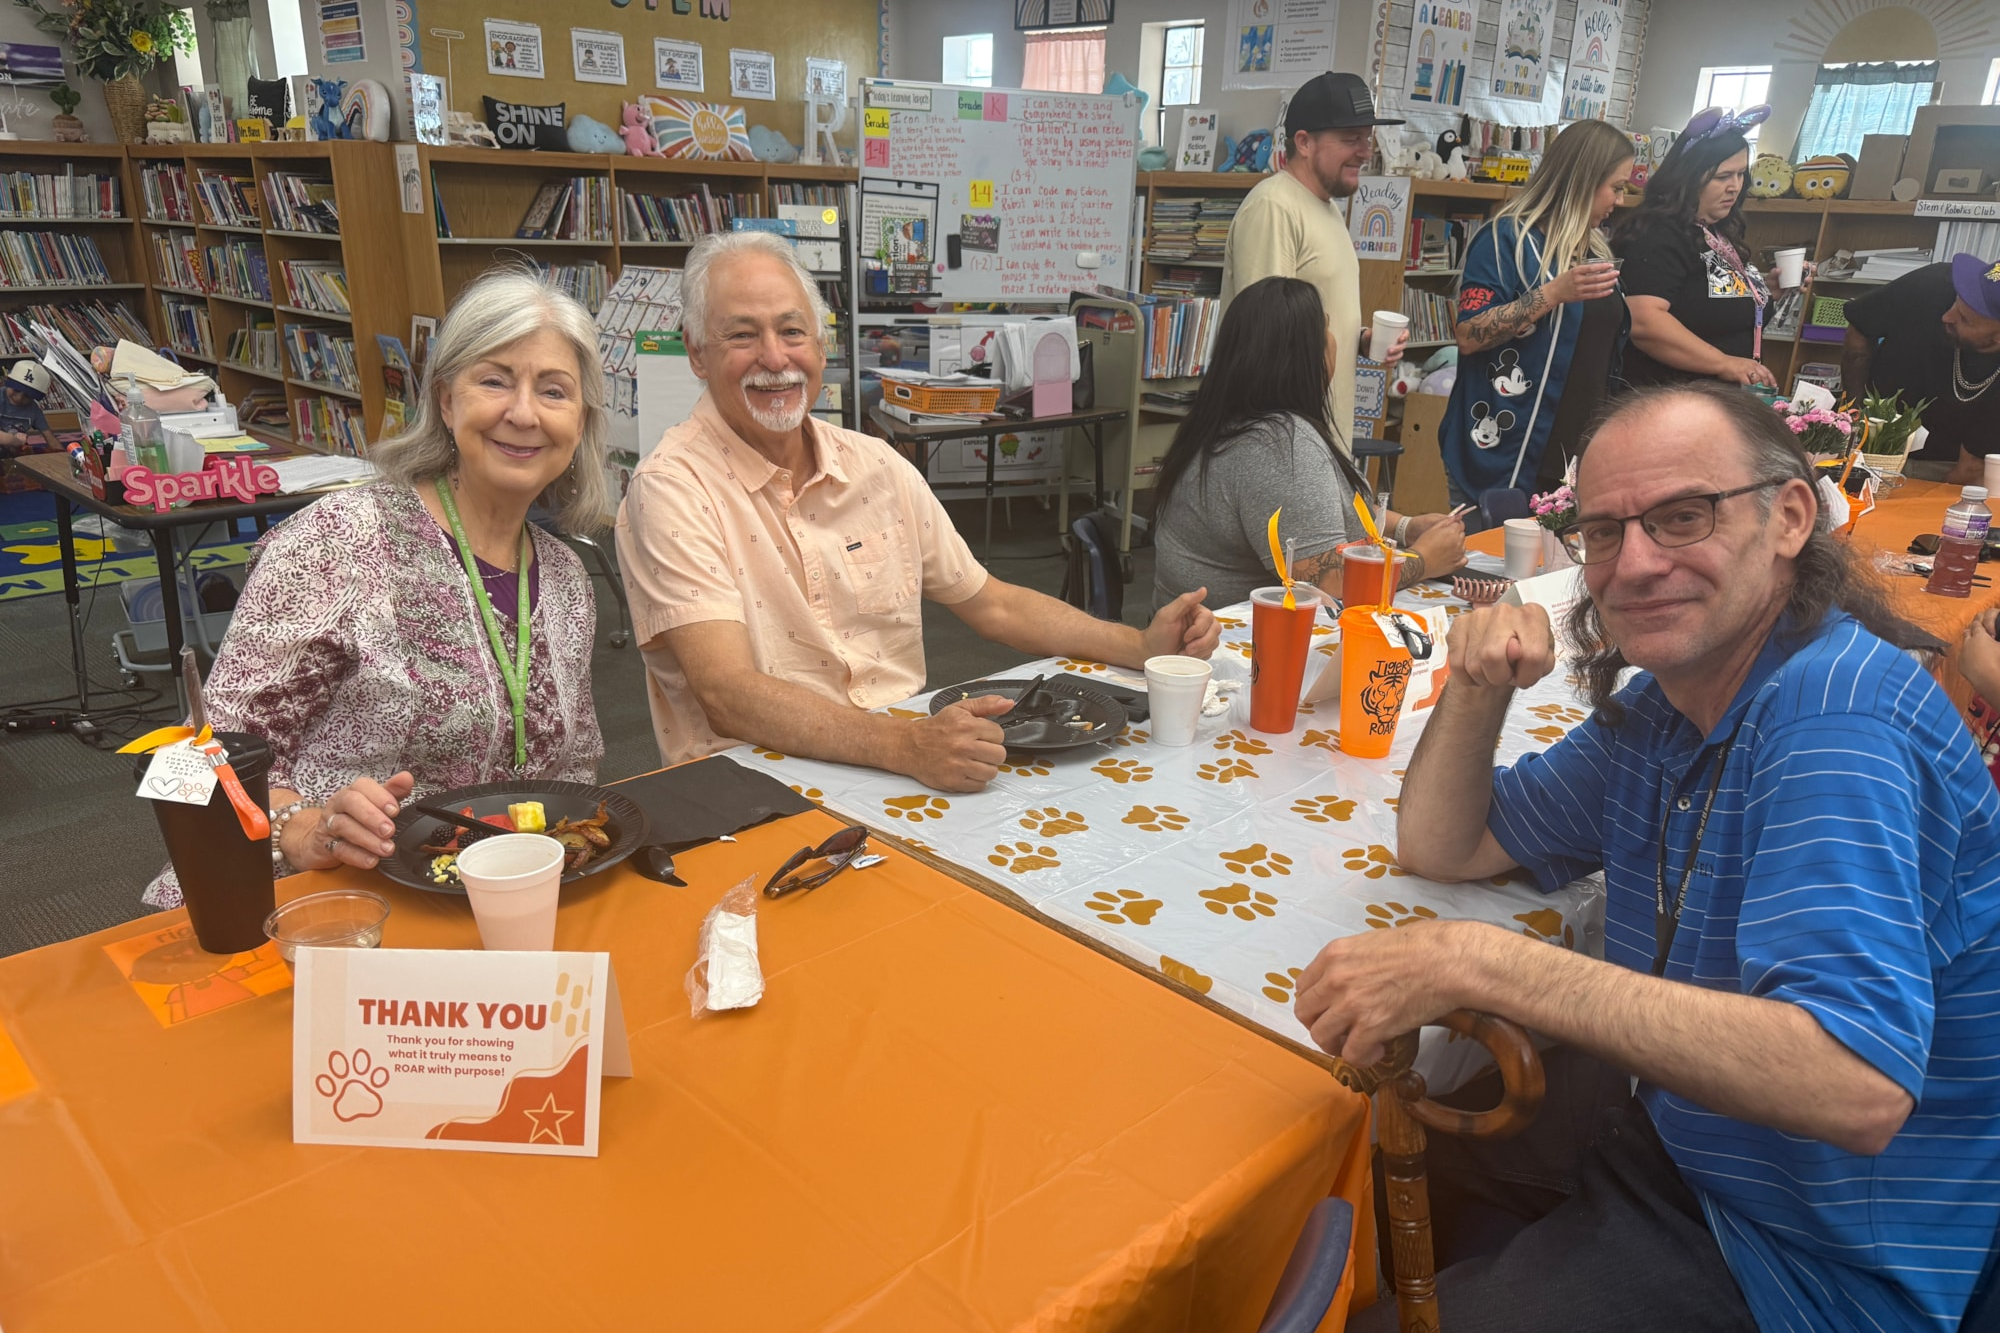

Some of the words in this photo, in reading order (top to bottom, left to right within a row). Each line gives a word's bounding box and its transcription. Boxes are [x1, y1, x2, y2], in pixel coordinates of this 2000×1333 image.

[1418, 3, 1428, 24] A
[1431, 5, 1472, 32] LEADER
[1584, 9, 1612, 42] BOOKS
[491, 32, 537, 44] ENCOURAGEMENT
[578, 42, 618, 52] PERSEVERANCE
[735, 62, 770, 71] IMPROVEMENT
[1514, 64, 1529, 79] YOU
[814, 69, 841, 80] PATIENCE
[1494, 79, 1541, 98] EVERYWHERE
[1571, 79, 1579, 91] so
[1579, 74, 1593, 92] little
[1593, 76, 1606, 95] time
[420, 97, 437, 109] Easy
[890, 92, 911, 105] Learning
[1033, 100, 1049, 109] can
[1054, 99, 1077, 110] listen
[1093, 100, 1112, 111] and
[958, 97, 983, 110] Grades
[991, 96, 1002, 117] K
[495, 102, 563, 127] SHINE
[864, 112, 889, 129] Grades
[903, 115, 920, 124] can
[696, 113, 724, 131] hello
[497, 122, 536, 145] ON
[1082, 126, 1099, 135] can
[1079, 137, 1101, 150] using
[1191, 135, 1206, 143] easy
[864, 139, 886, 165] 1-4
[1012, 186, 1031, 196] can
[1038, 185, 1058, 196] code
[1065, 187, 1078, 200] my
[1080, 186, 1108, 197] Edison
[1359, 181, 1403, 210] Reading
[1001, 199, 1026, 211] Robot
[1033, 198, 1056, 209] with
[1081, 200, 1113, 216] partner
[1917, 200, 1939, 212] Stem
[1944, 203, 1972, 215] Robotics
[1973, 205, 1996, 216] Club
[1017, 212, 1046, 224] create
[1020, 227, 1035, 238] can
[1039, 226, 1061, 238] write
[1353, 241, 1397, 253] CORNER
[970, 254, 992, 273] (1-2)
[1006, 260, 1020, 270] can
[1022, 260, 1041, 271] code
[1001, 272, 1027, 282] mouse
[1001, 284, 1025, 294] maze
[24, 368, 34, 384] LA
[1356, 384, 1375, 394] Down
[125, 460, 278, 509] Sparkle
[1369, 721, 1396, 736] ROAR
[166, 755, 193, 764] THANK
[1700, 819, 1706, 828] of
[1696, 828, 1705, 840] City
[1681, 869, 1692, 892] Mirage
[1678, 899, 1685, 909] of
[1674, 907, 1683, 920] City
[358, 998, 470, 1028] THANK
[476, 1002, 548, 1031] YOU
[386, 1034, 422, 1046] Thank
[424, 1037, 446, 1048] you
[447, 1036, 464, 1047] for
[466, 1037, 515, 1051] showing
[388, 1049, 418, 1060] what
[419, 1050, 428, 1060] it
[429, 1050, 457, 1063] truly
[458, 1052, 498, 1063] means
[499, 1053, 512, 1063] to
[394, 1064, 425, 1074] ROAR
[427, 1064, 452, 1075] with
[454, 1066, 505, 1079] purpose!
